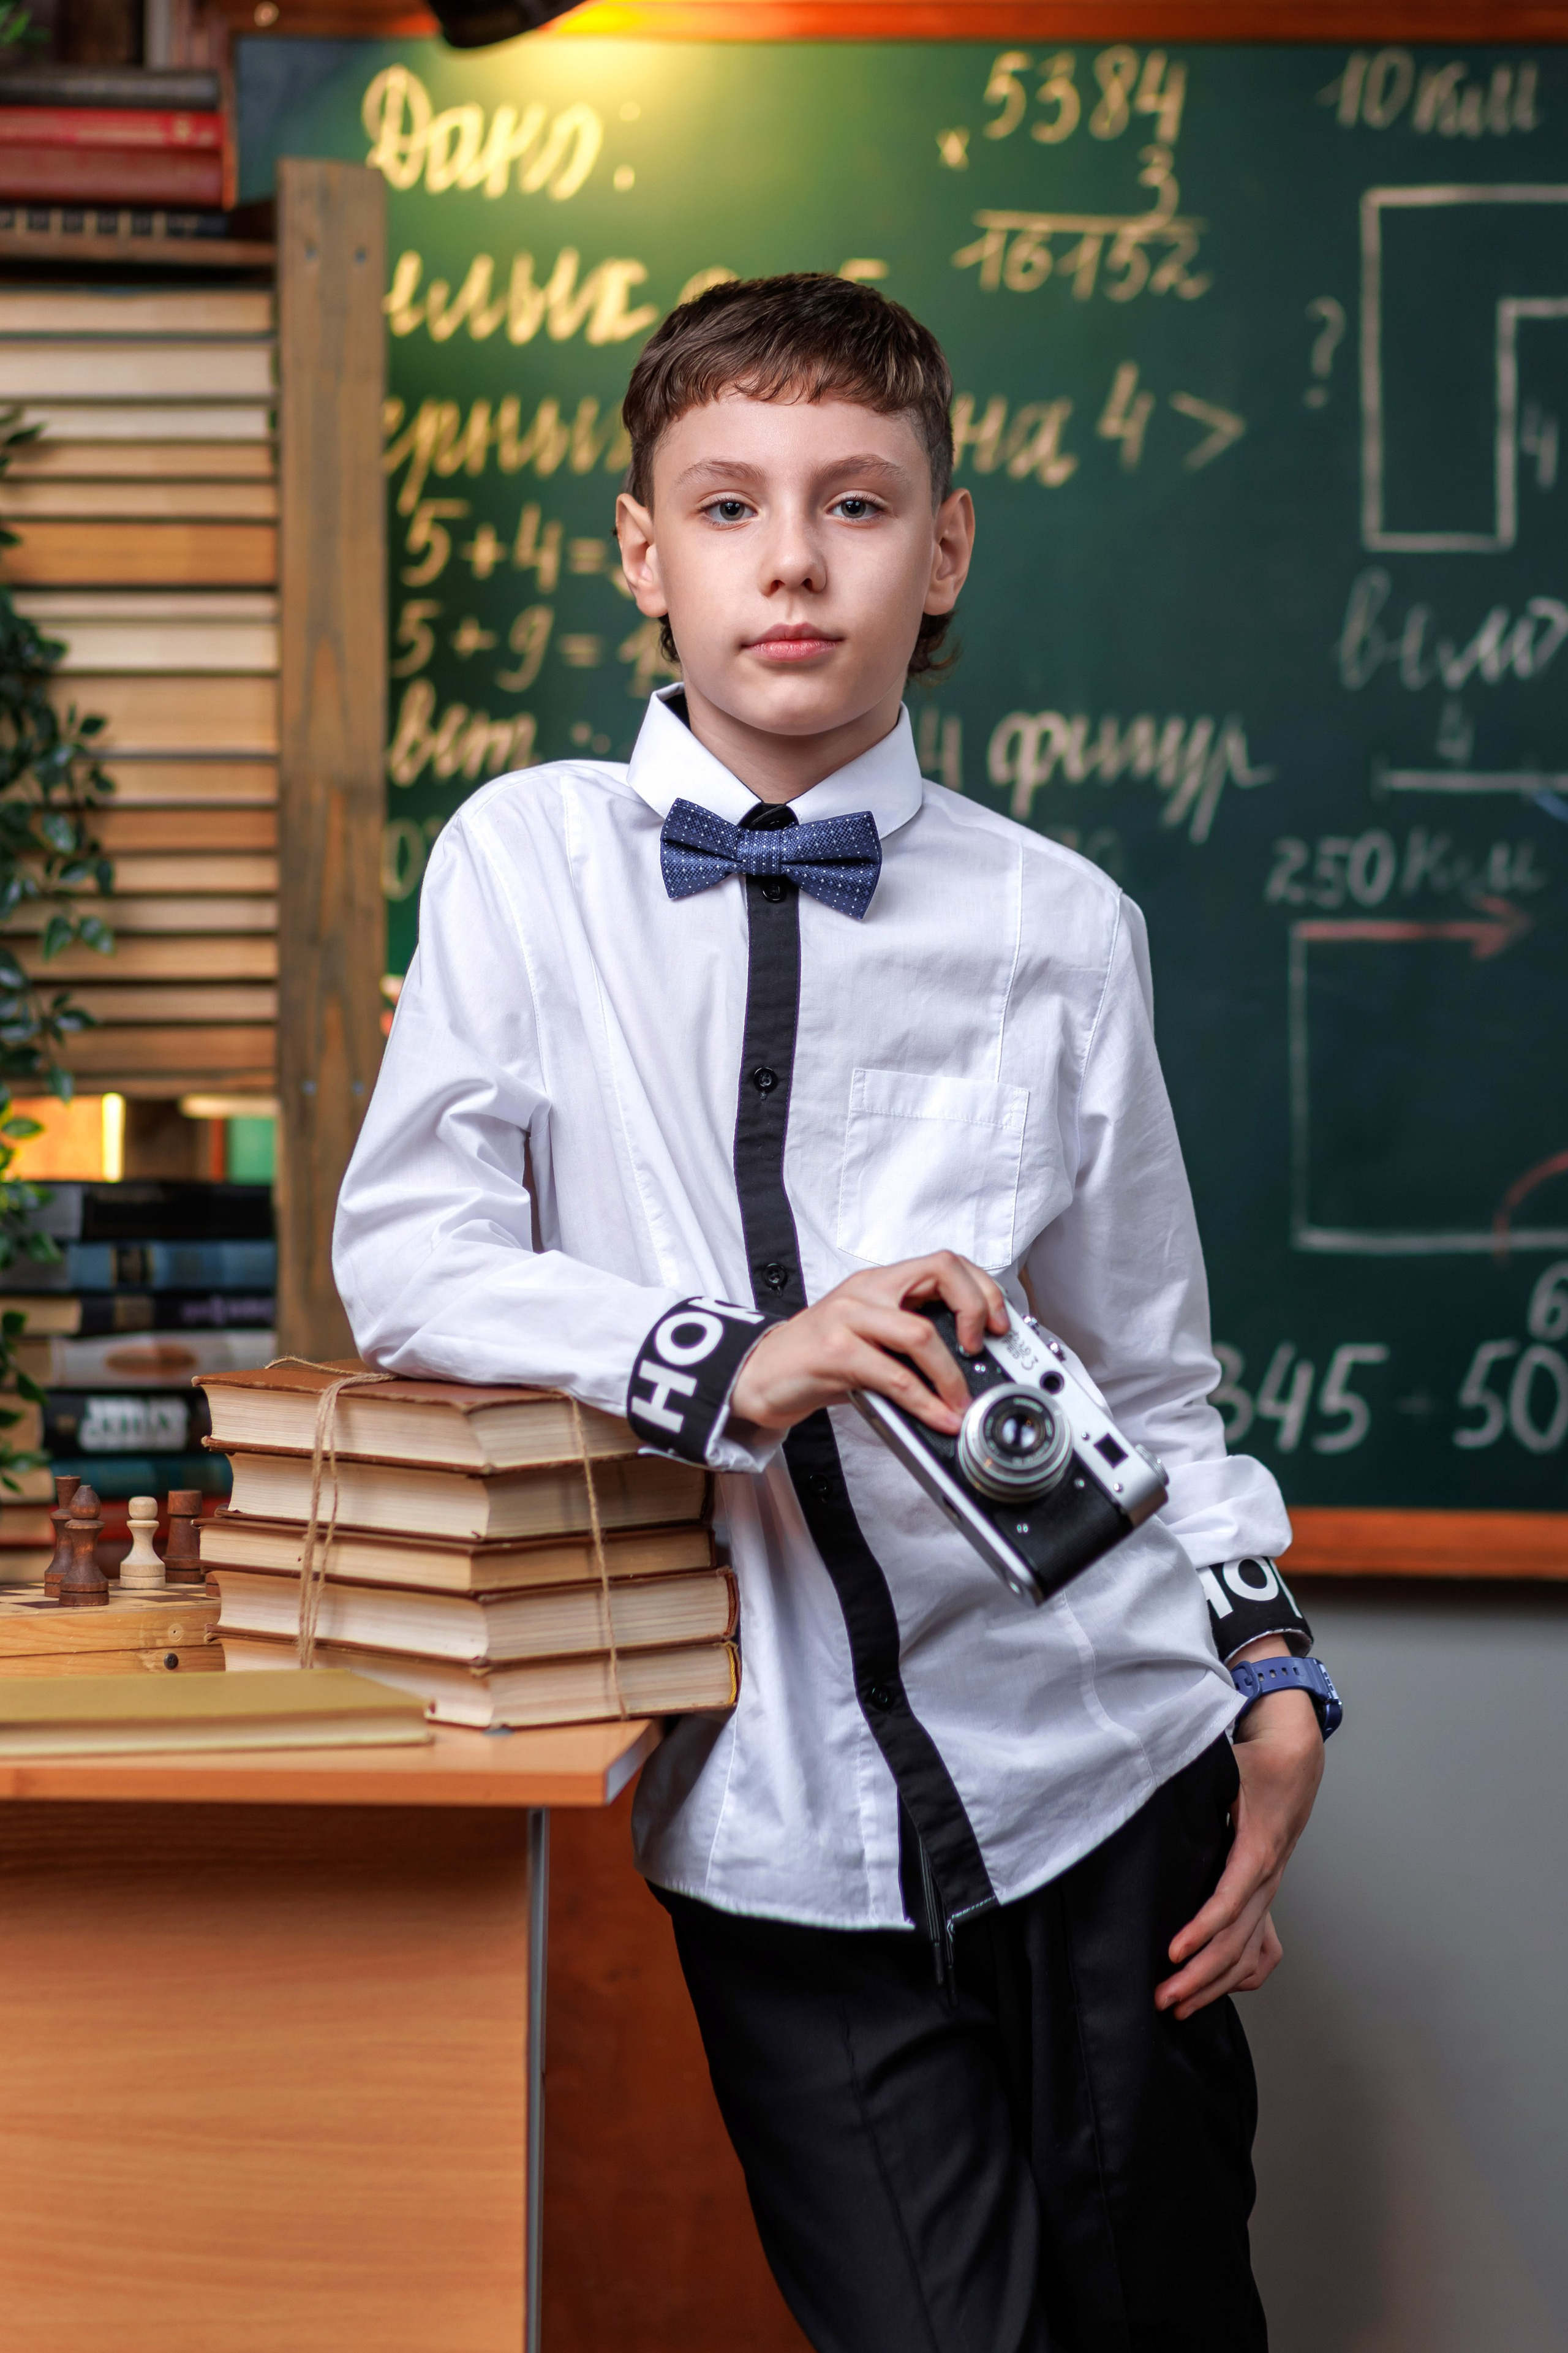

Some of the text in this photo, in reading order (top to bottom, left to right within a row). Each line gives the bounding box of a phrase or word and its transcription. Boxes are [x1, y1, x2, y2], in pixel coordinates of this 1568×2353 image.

[983, 45, 1186, 145] 5384
[951, 216, 1213, 300] 16152
[1096, 360, 1155, 474] 4
